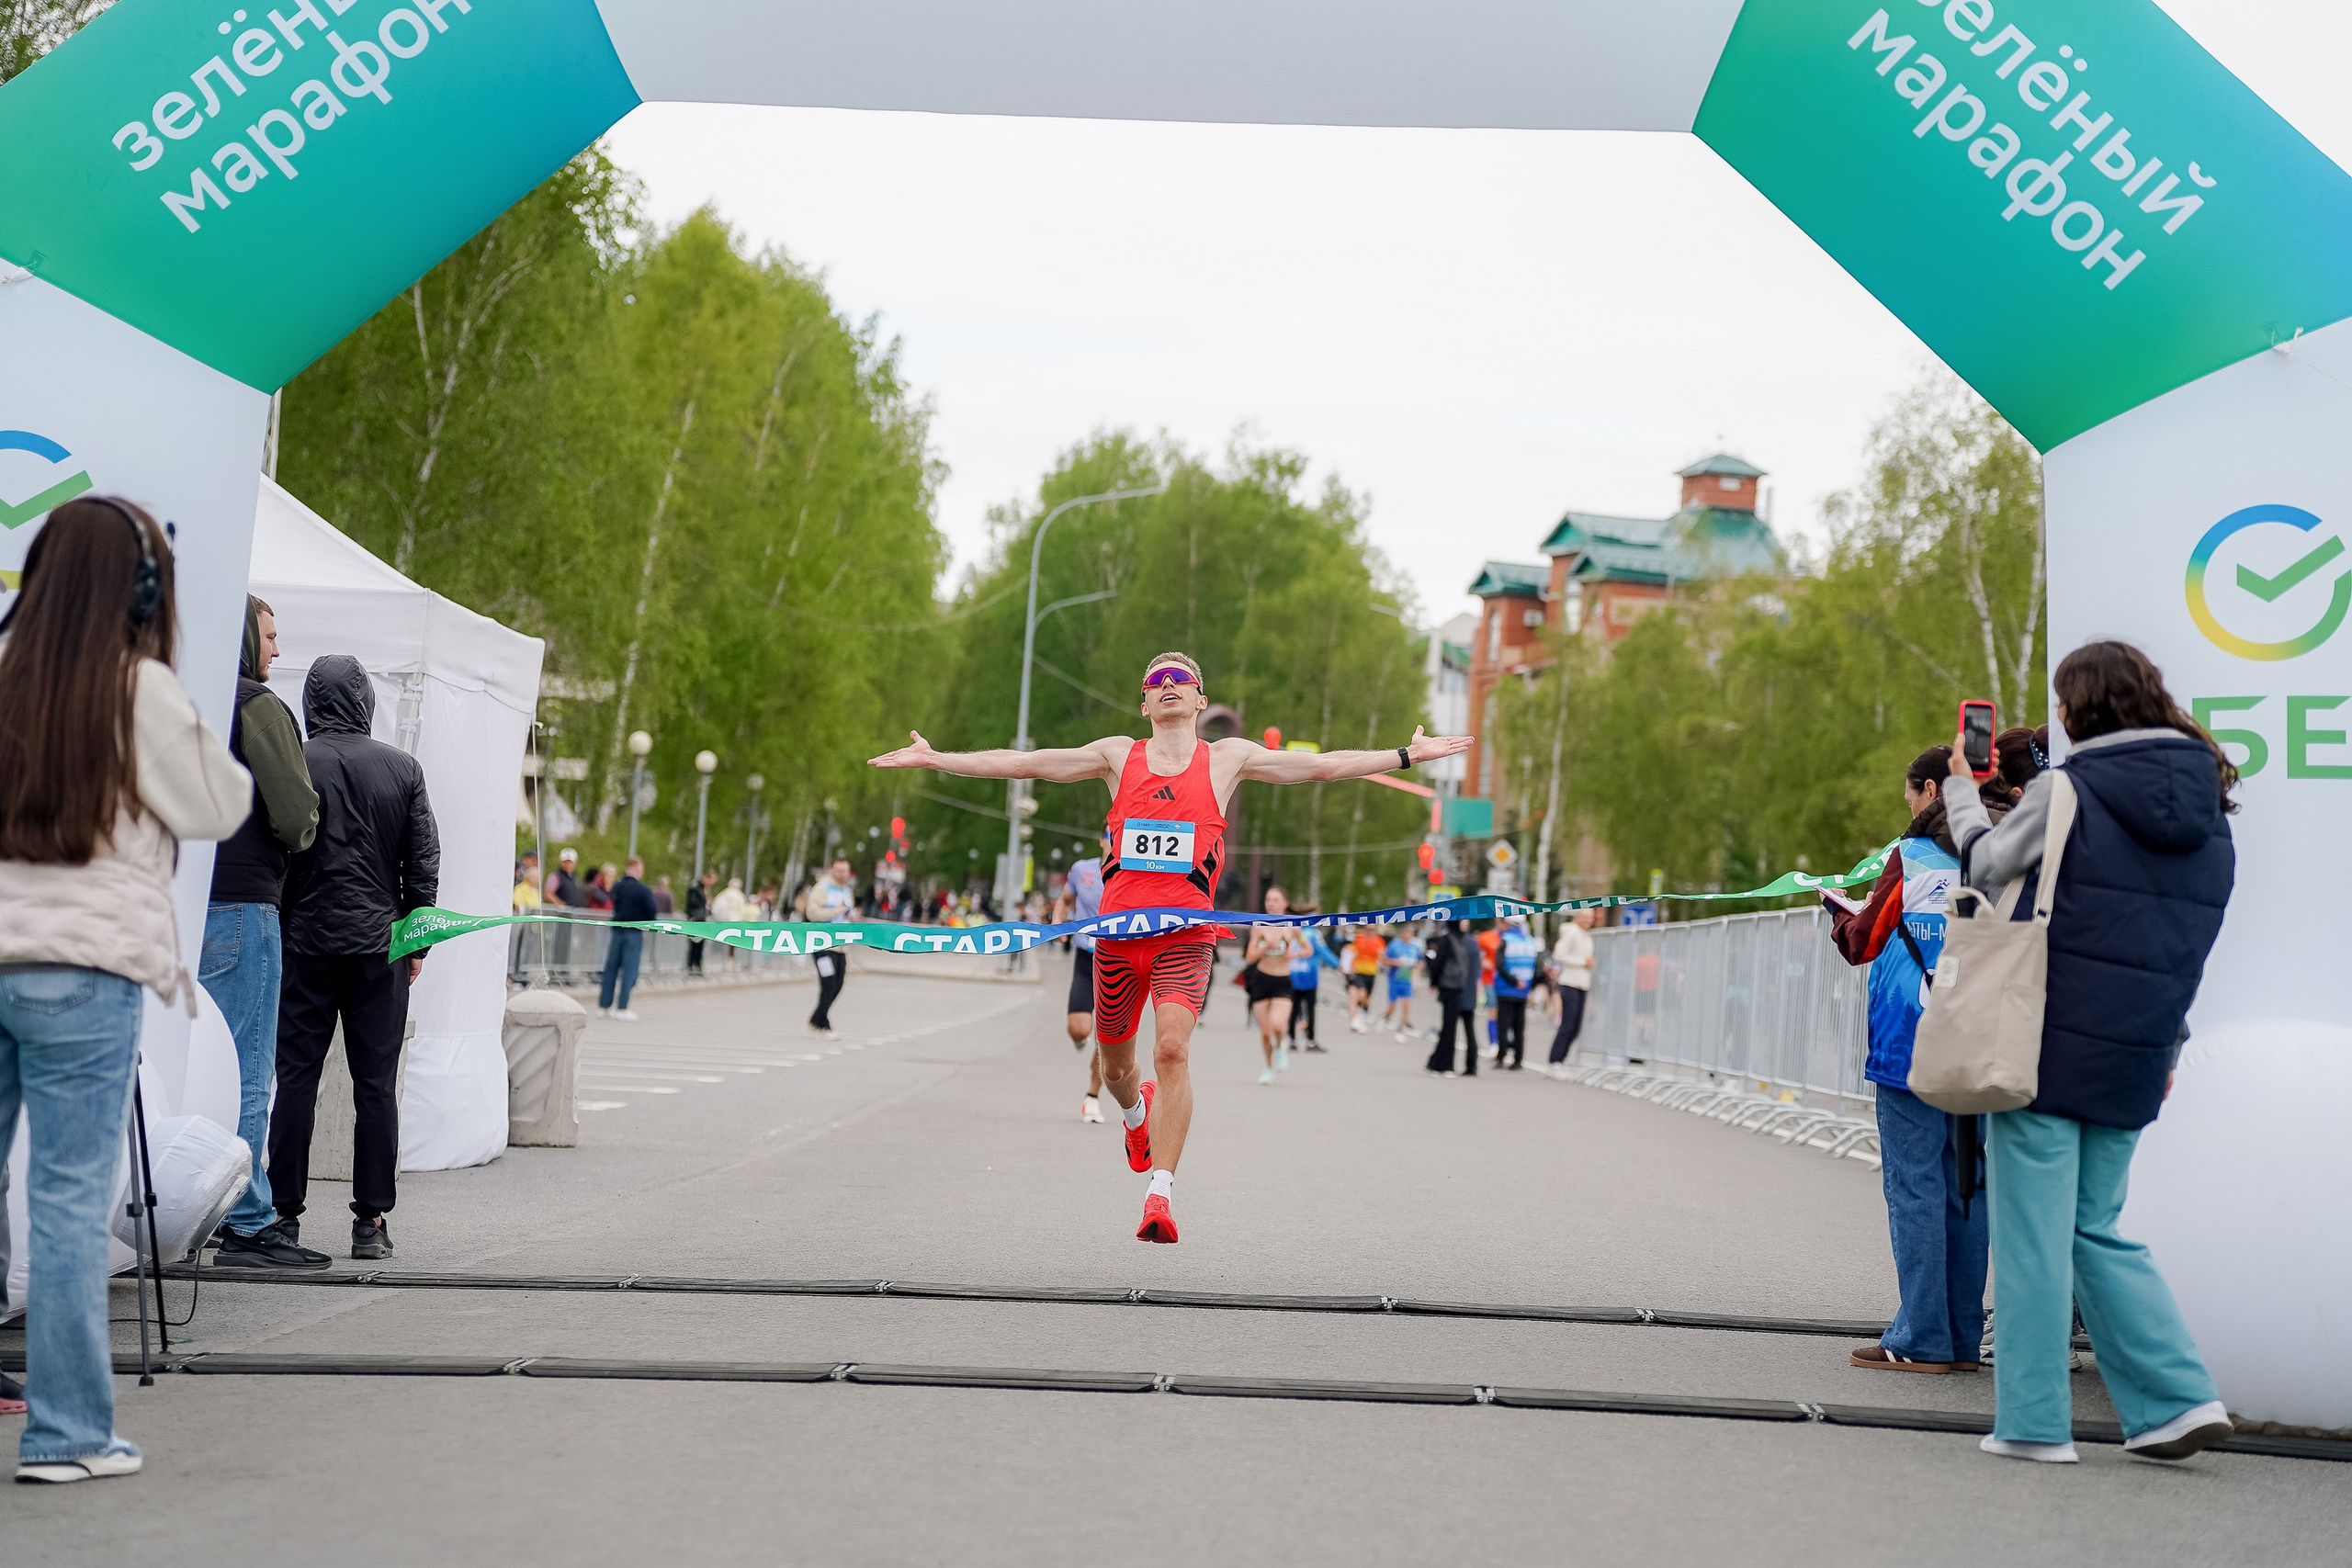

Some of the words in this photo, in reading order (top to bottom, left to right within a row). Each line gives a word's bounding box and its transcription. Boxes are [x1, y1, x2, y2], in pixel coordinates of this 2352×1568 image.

[111, 0, 358, 172] зелён
[1917, 0, 2218, 235] елёный
[1847, 7, 2147, 290] марафон
[1136, 834, 1179, 856] 812
[412, 914, 447, 927] зелё
[894, 929, 1041, 954] СТАРТ
